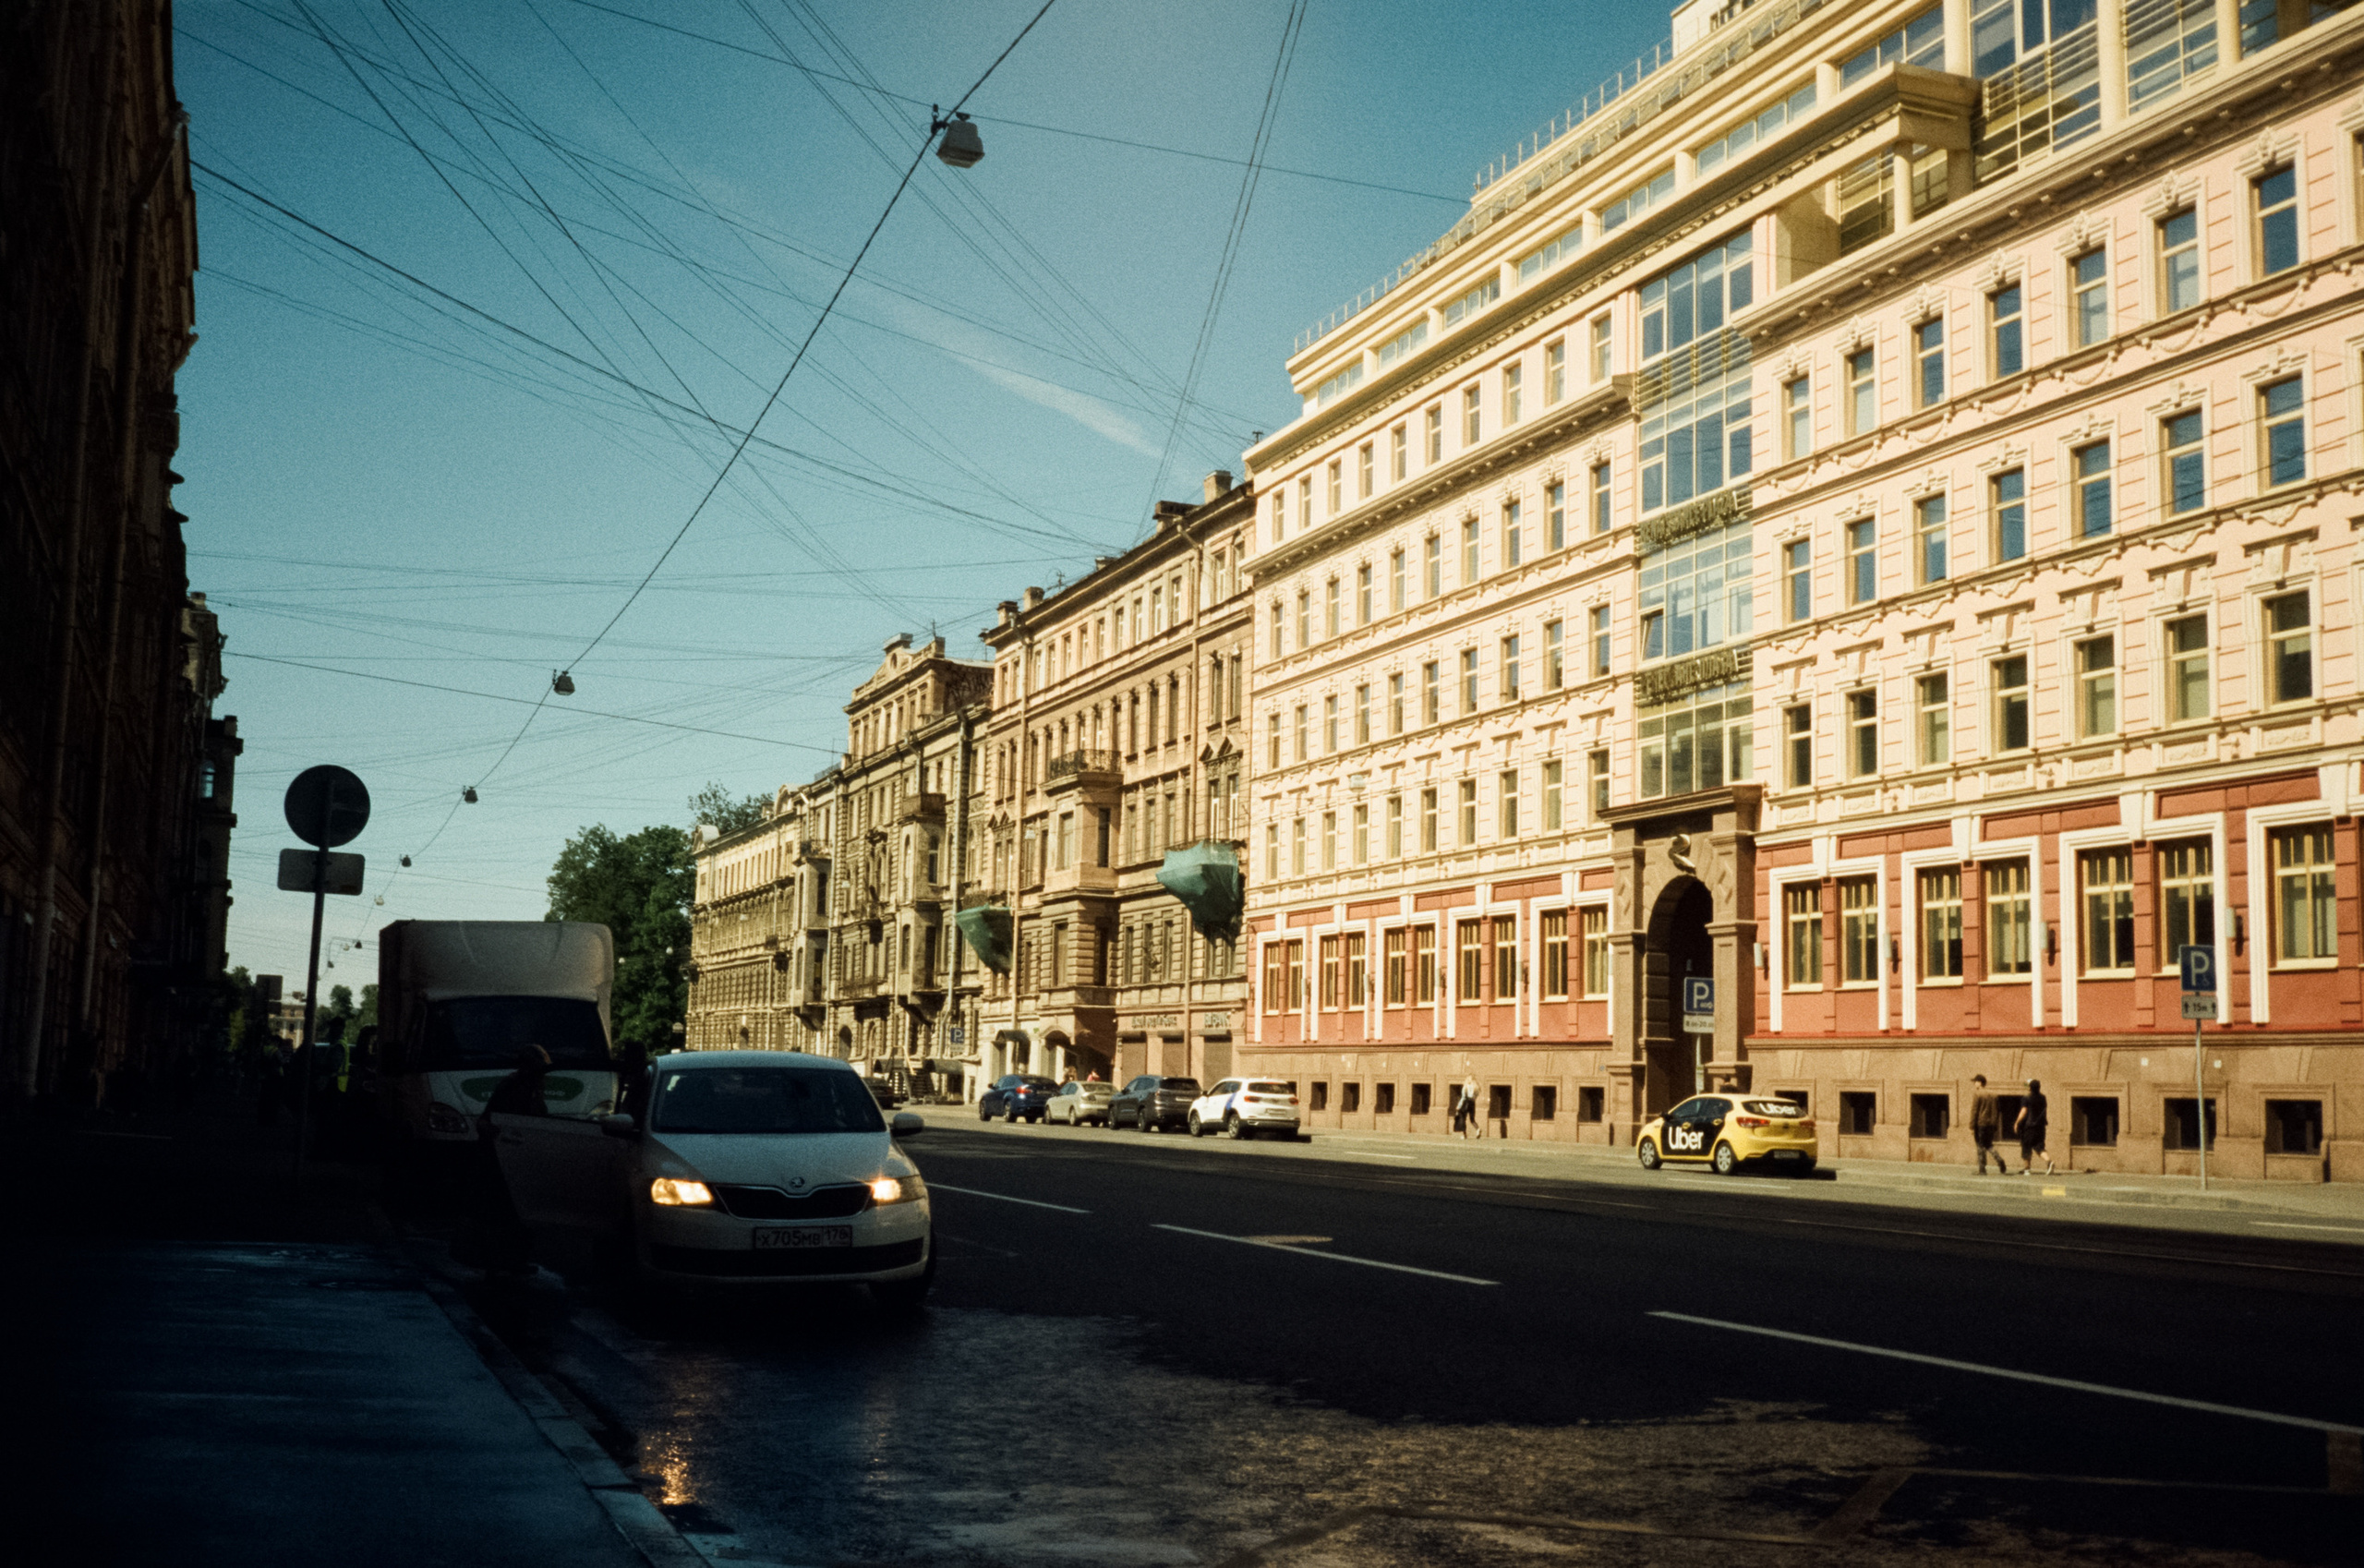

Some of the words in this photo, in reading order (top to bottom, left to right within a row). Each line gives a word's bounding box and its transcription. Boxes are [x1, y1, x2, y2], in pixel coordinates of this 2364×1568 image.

[2190, 950, 2210, 986] P
[1693, 982, 1710, 1009] P
[954, 1029, 963, 1042] P
[1759, 1103, 1797, 1116] Uber
[1668, 1126, 1705, 1151] Uber
